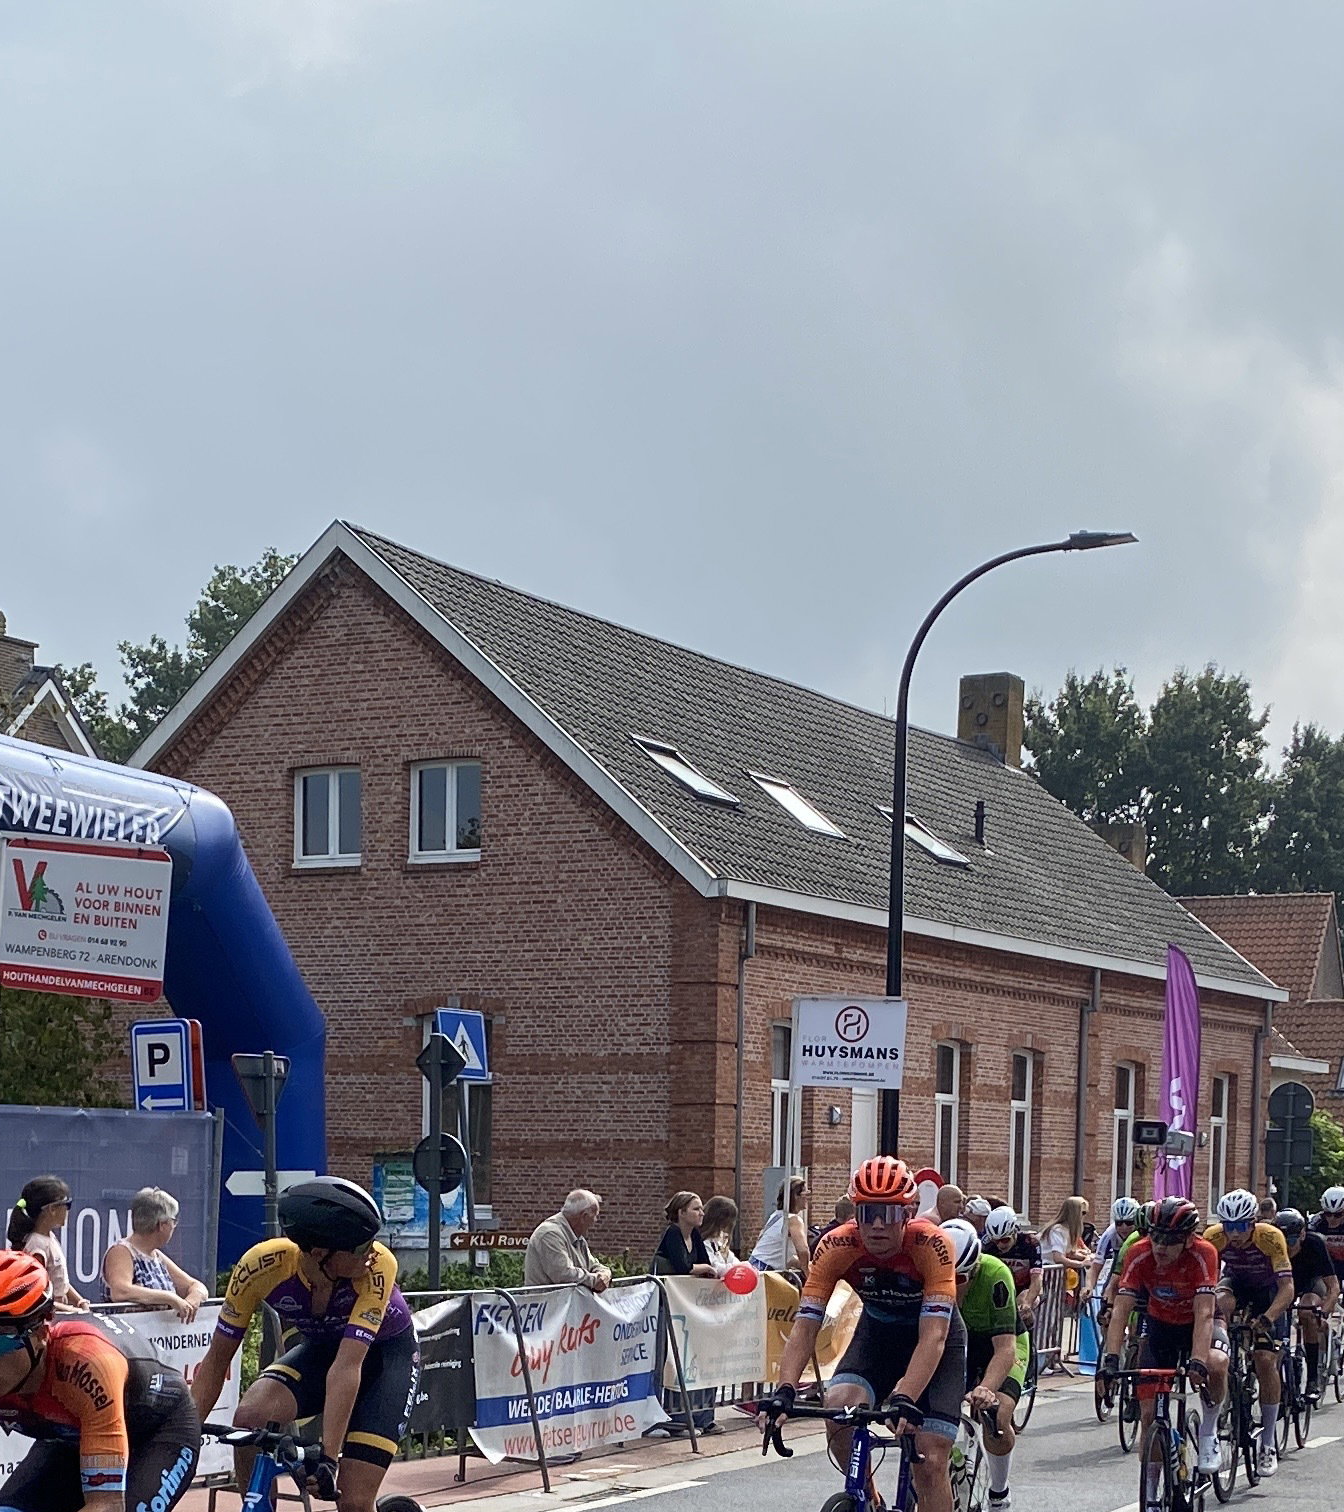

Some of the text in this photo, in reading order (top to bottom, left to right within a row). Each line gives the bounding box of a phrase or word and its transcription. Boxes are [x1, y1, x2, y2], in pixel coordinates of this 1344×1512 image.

[75, 882, 163, 901] AL UW HOUT
[75, 897, 161, 917] VOOR BINNEN
[74, 913, 138, 930] EN BUITEN
[5, 944, 77, 960] WAMPENBERG
[78, 951, 90, 961] 72
[97, 953, 158, 969] ARENDONK
[147, 1042, 170, 1078] P
[802, 1045, 899, 1061] HUYSMANS
[469, 1235, 496, 1246] KLJ
